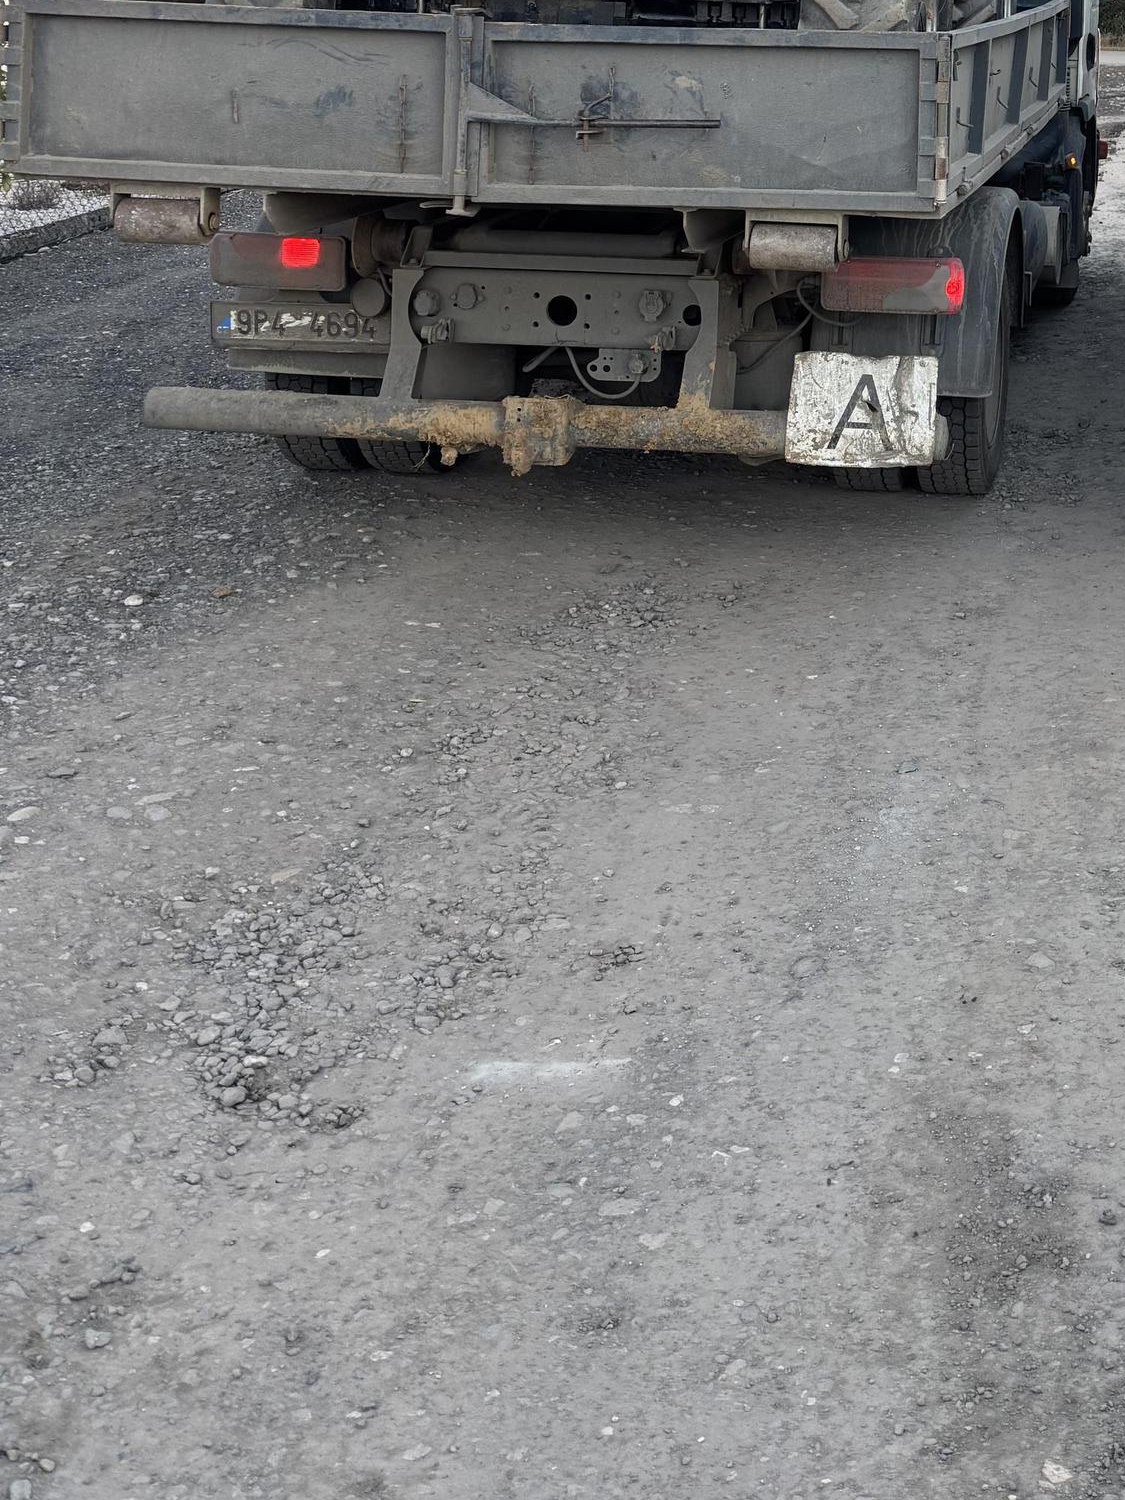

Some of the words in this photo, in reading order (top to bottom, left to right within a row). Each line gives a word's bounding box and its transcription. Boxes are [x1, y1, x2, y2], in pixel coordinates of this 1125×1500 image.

[237, 309, 287, 337] 9P4
[309, 311, 377, 339] 4694
[827, 373, 894, 451] A
